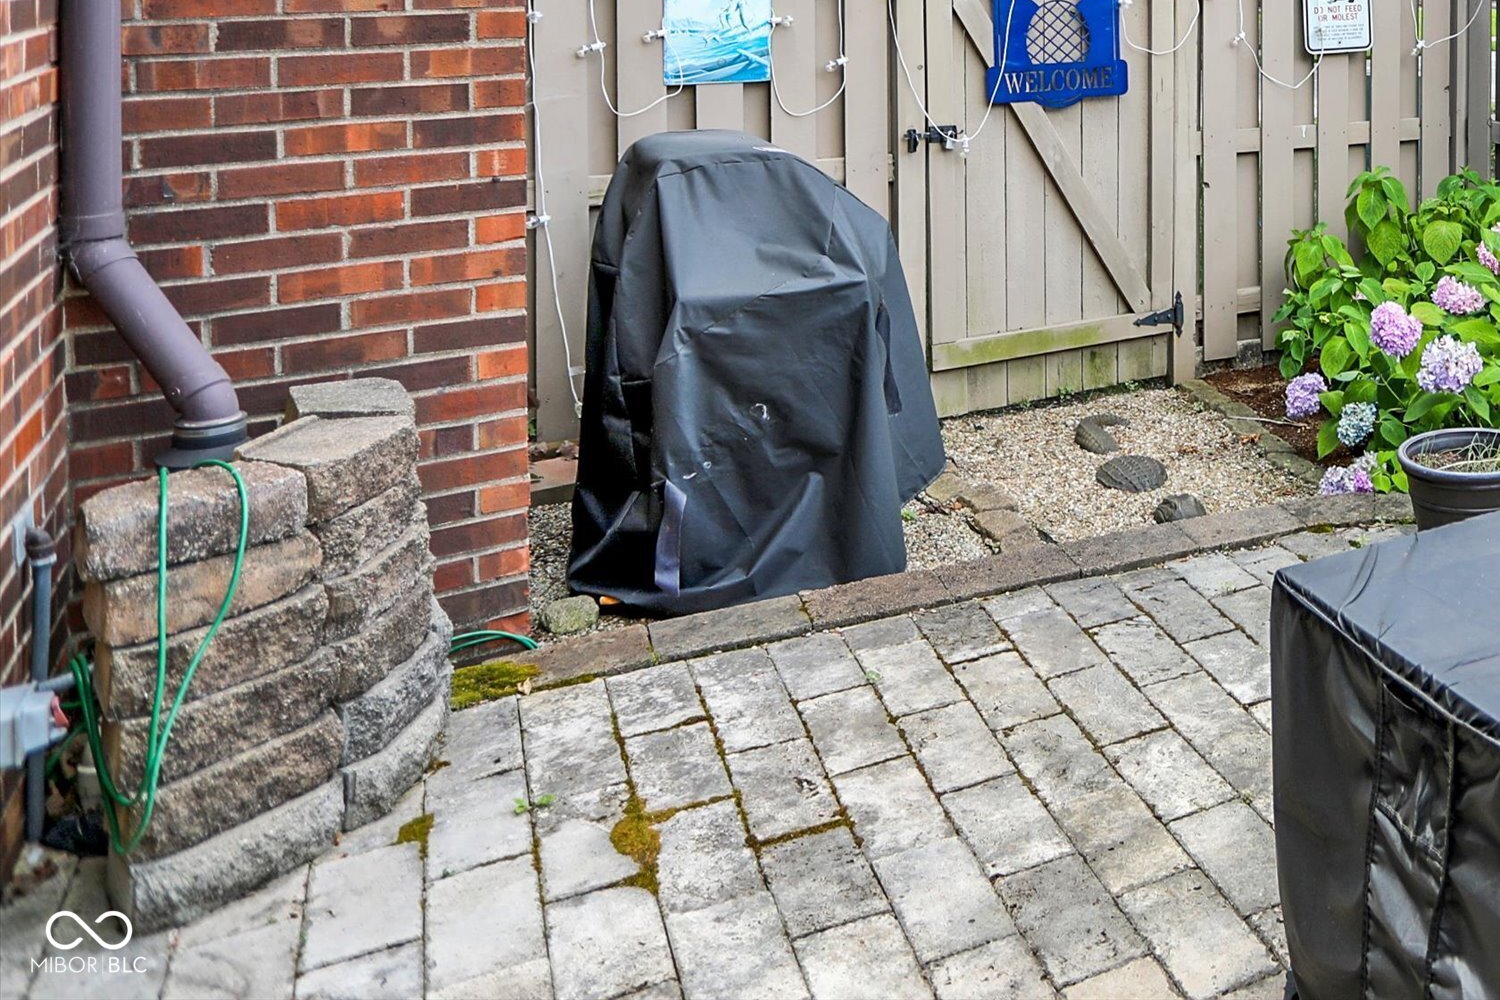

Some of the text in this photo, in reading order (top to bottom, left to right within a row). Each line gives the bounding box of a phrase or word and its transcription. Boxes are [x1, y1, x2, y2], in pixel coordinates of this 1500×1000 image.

[1327, 5, 1341, 14] NOT
[1331, 12, 1358, 21] MOLEST
[1004, 66, 1113, 95] WELCOME
